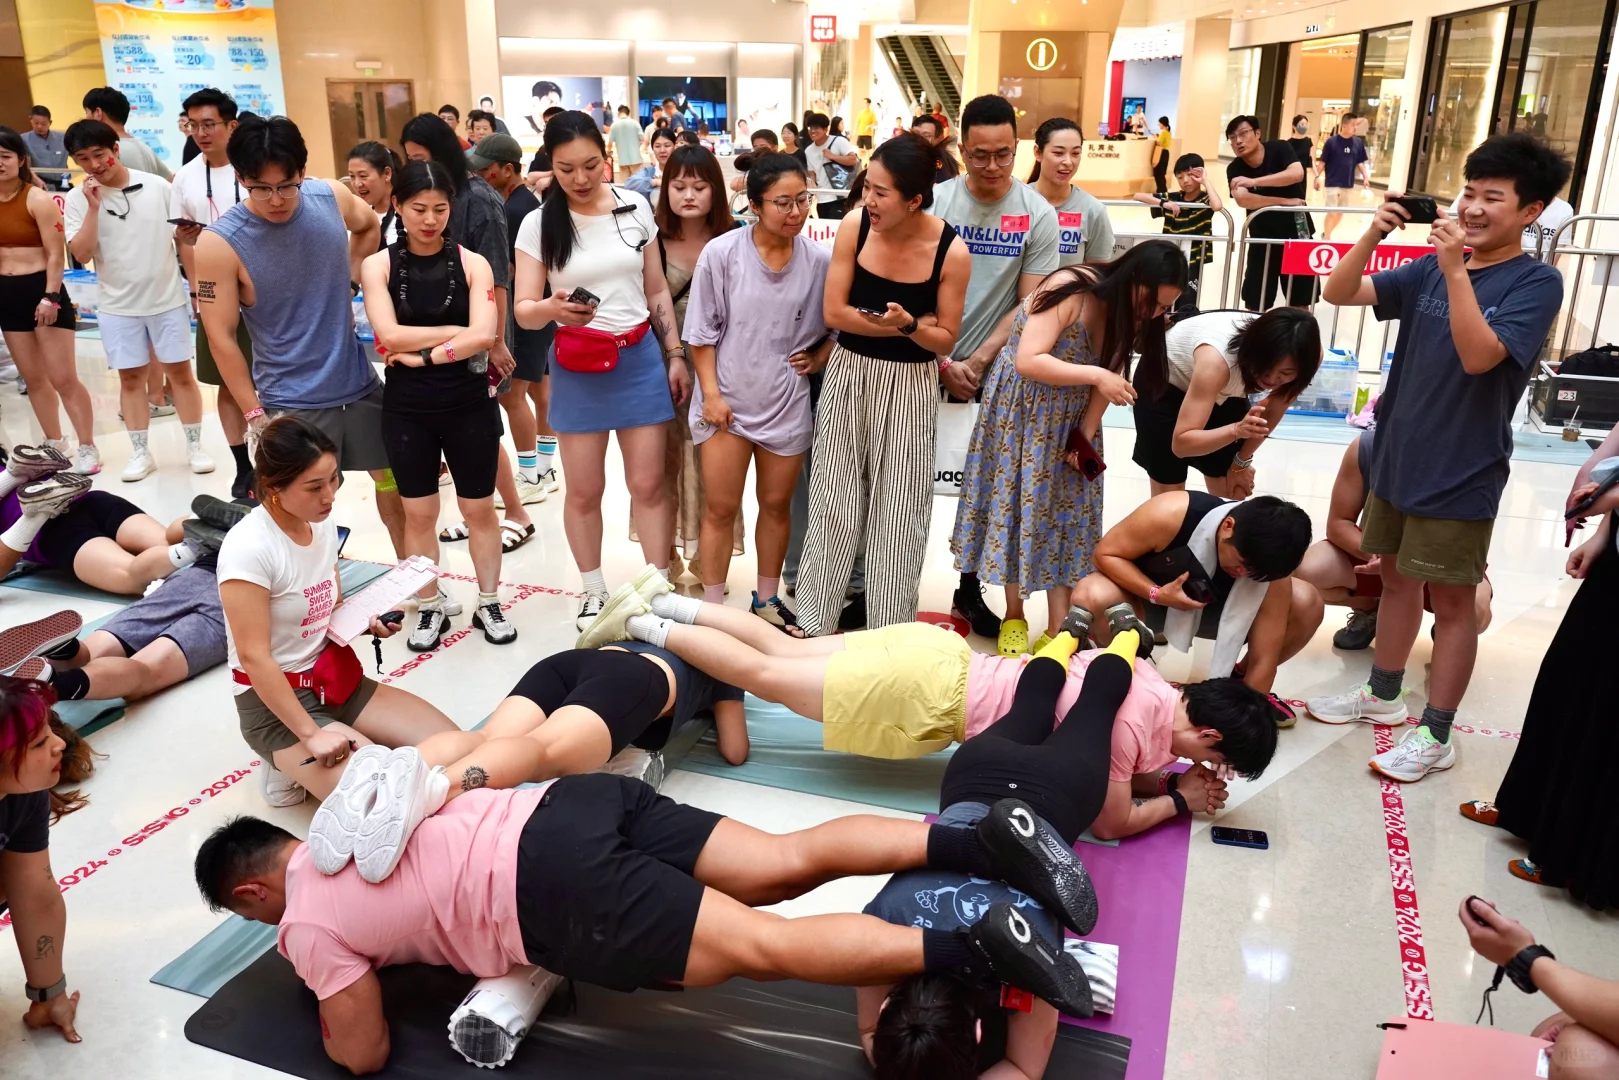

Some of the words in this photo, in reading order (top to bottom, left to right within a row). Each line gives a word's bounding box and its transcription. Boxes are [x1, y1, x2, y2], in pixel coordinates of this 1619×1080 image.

[954, 225, 1025, 244] AN&LION
[972, 244, 1021, 256] POWERFUL
[934, 471, 964, 487] uag
[303, 579, 333, 598] SUMMER
[309, 589, 332, 607] SWEAT
[308, 599, 333, 617] GAMES
[201, 768, 251, 798] 2024
[1384, 806, 1407, 838] 2024
[1397, 905, 1424, 948] 2024
